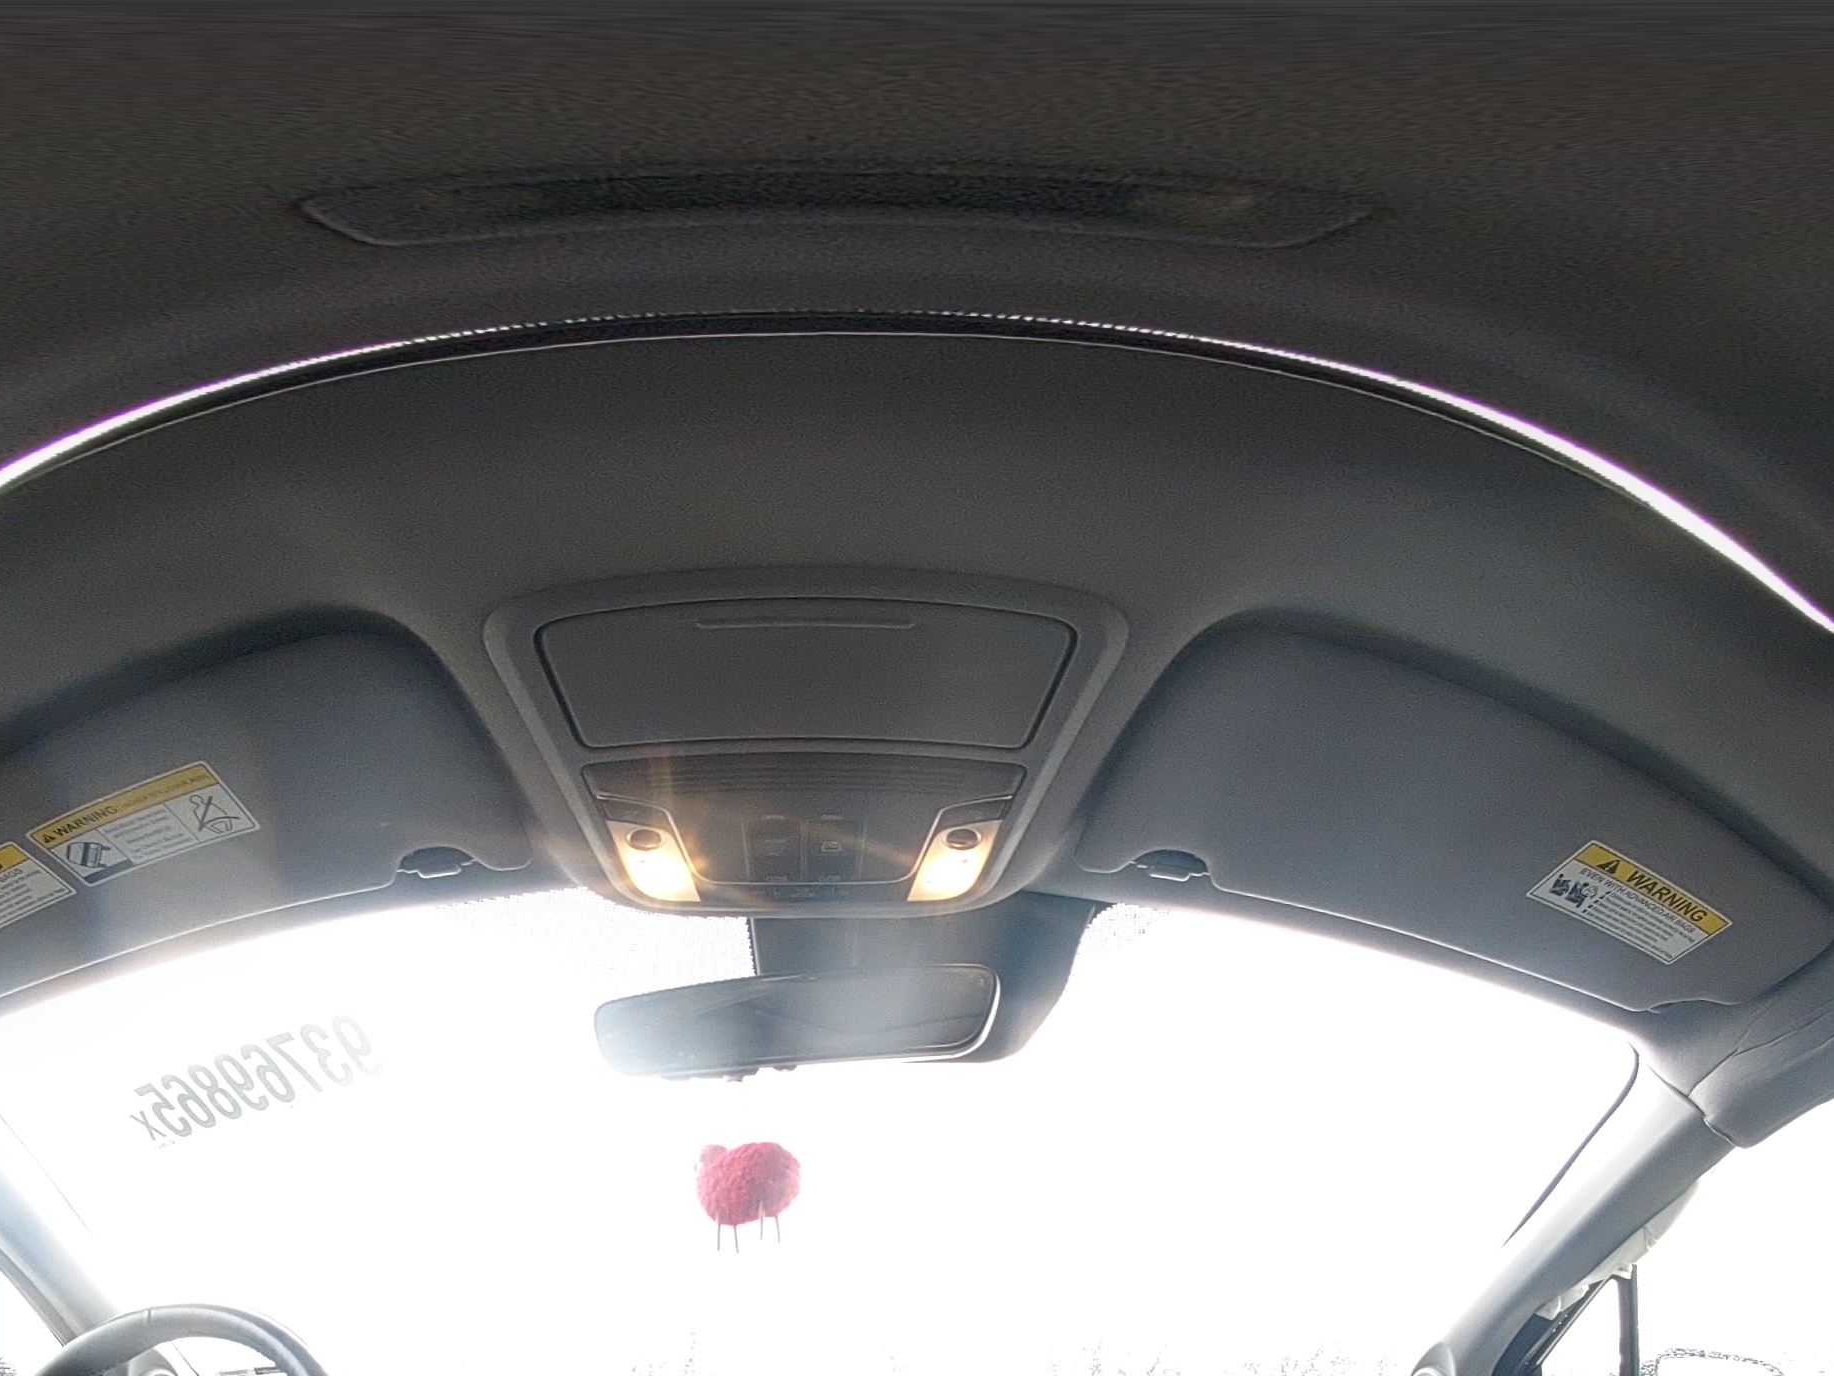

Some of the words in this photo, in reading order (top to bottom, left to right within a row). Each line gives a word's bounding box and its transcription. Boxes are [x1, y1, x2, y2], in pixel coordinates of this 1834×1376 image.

[53, 807, 119, 837] WARNING
[1580, 868, 1603, 885] EVEN
[1603, 879, 1625, 896] WITH
[1624, 890, 1664, 916] ADVANCED
[1675, 918, 1696, 933] BAGS
[1626, 871, 1708, 922] WARNING
